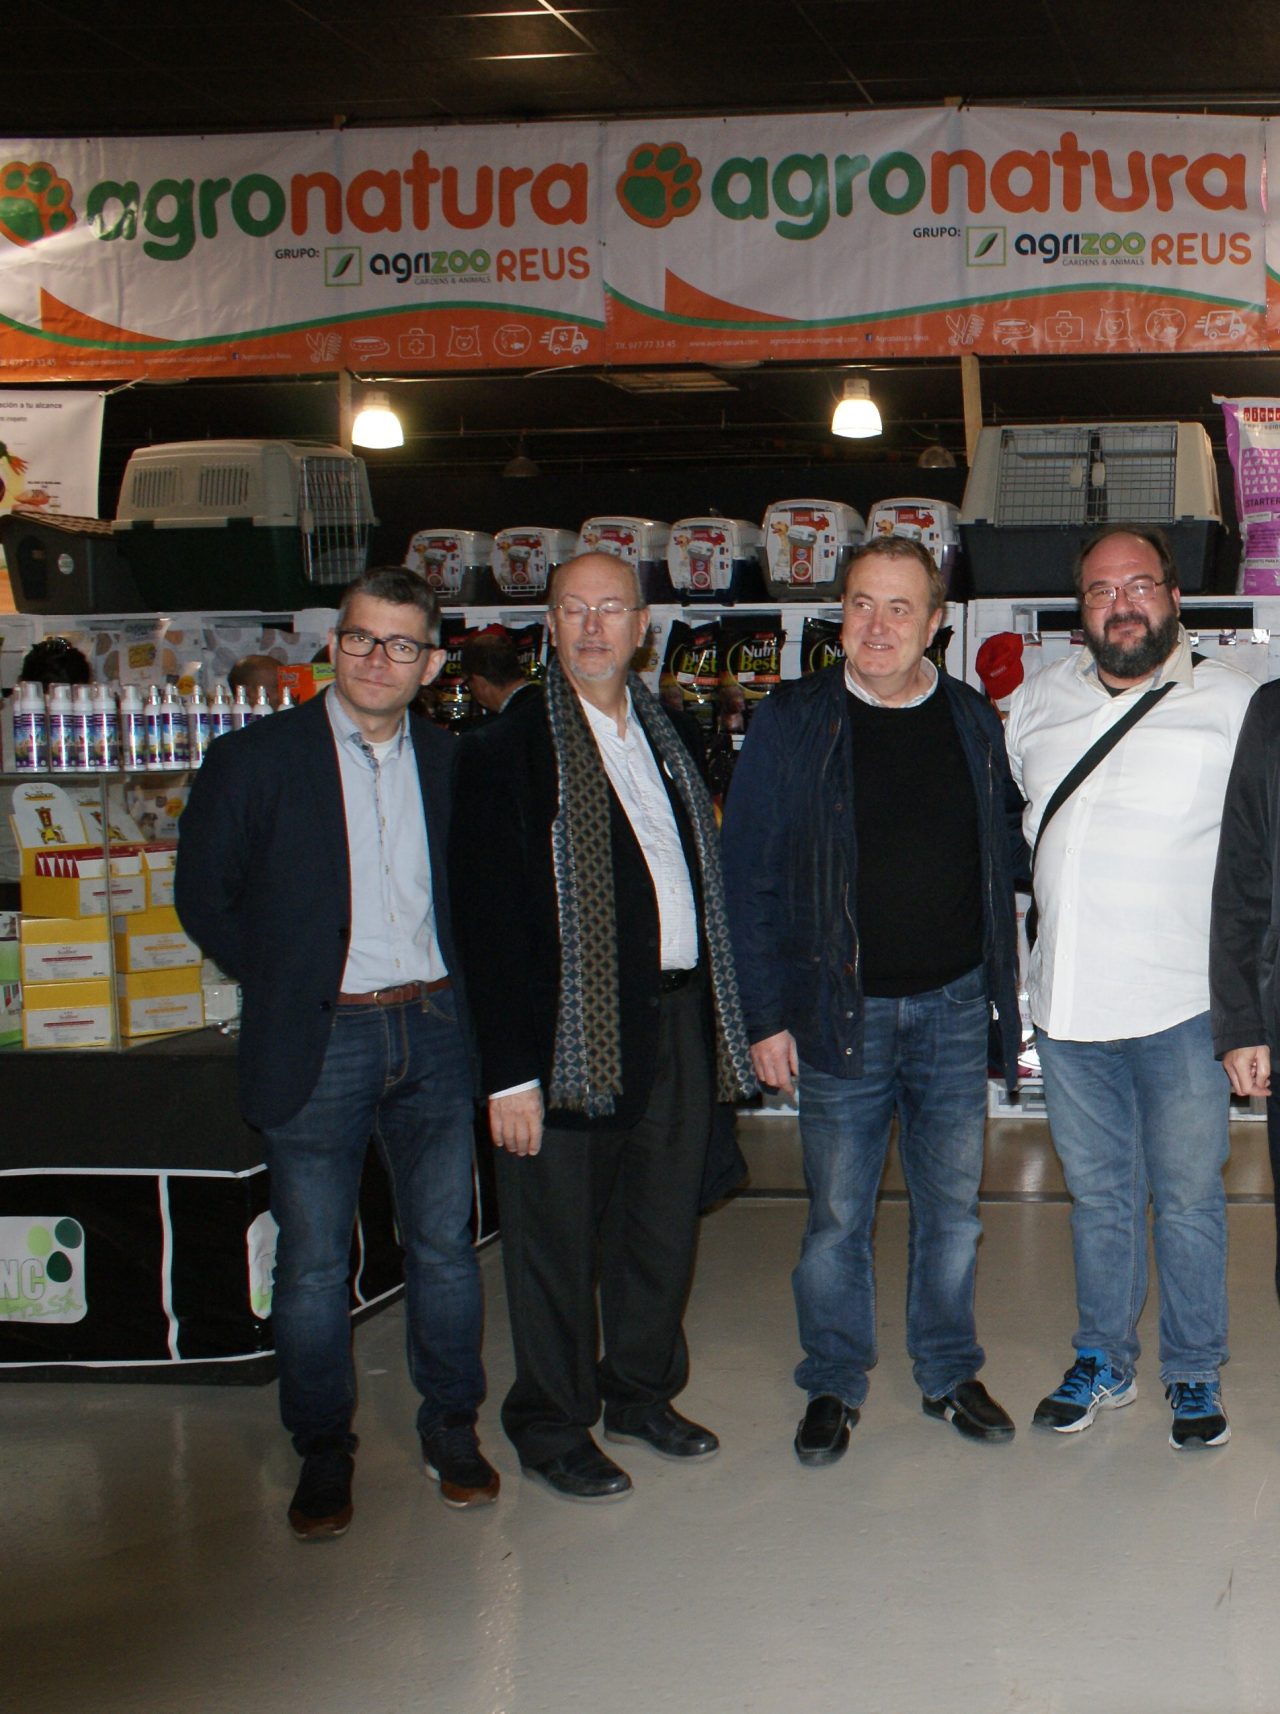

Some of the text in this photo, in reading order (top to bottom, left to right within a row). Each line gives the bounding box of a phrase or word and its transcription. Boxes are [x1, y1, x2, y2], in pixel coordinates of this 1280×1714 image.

[711, 131, 1248, 241] agronatura
[86, 149, 589, 262] agronatura
[913, 227, 961, 239] GRUPO:
[275, 247, 320, 260] GRUPO:
[1014, 231, 1252, 266] agrizoo REUS
[369, 245, 591, 285] agrizoo REUS
[742, 640, 777, 658] Nutri
[824, 644, 845, 657] Nu
[740, 656, 778, 672] Best
